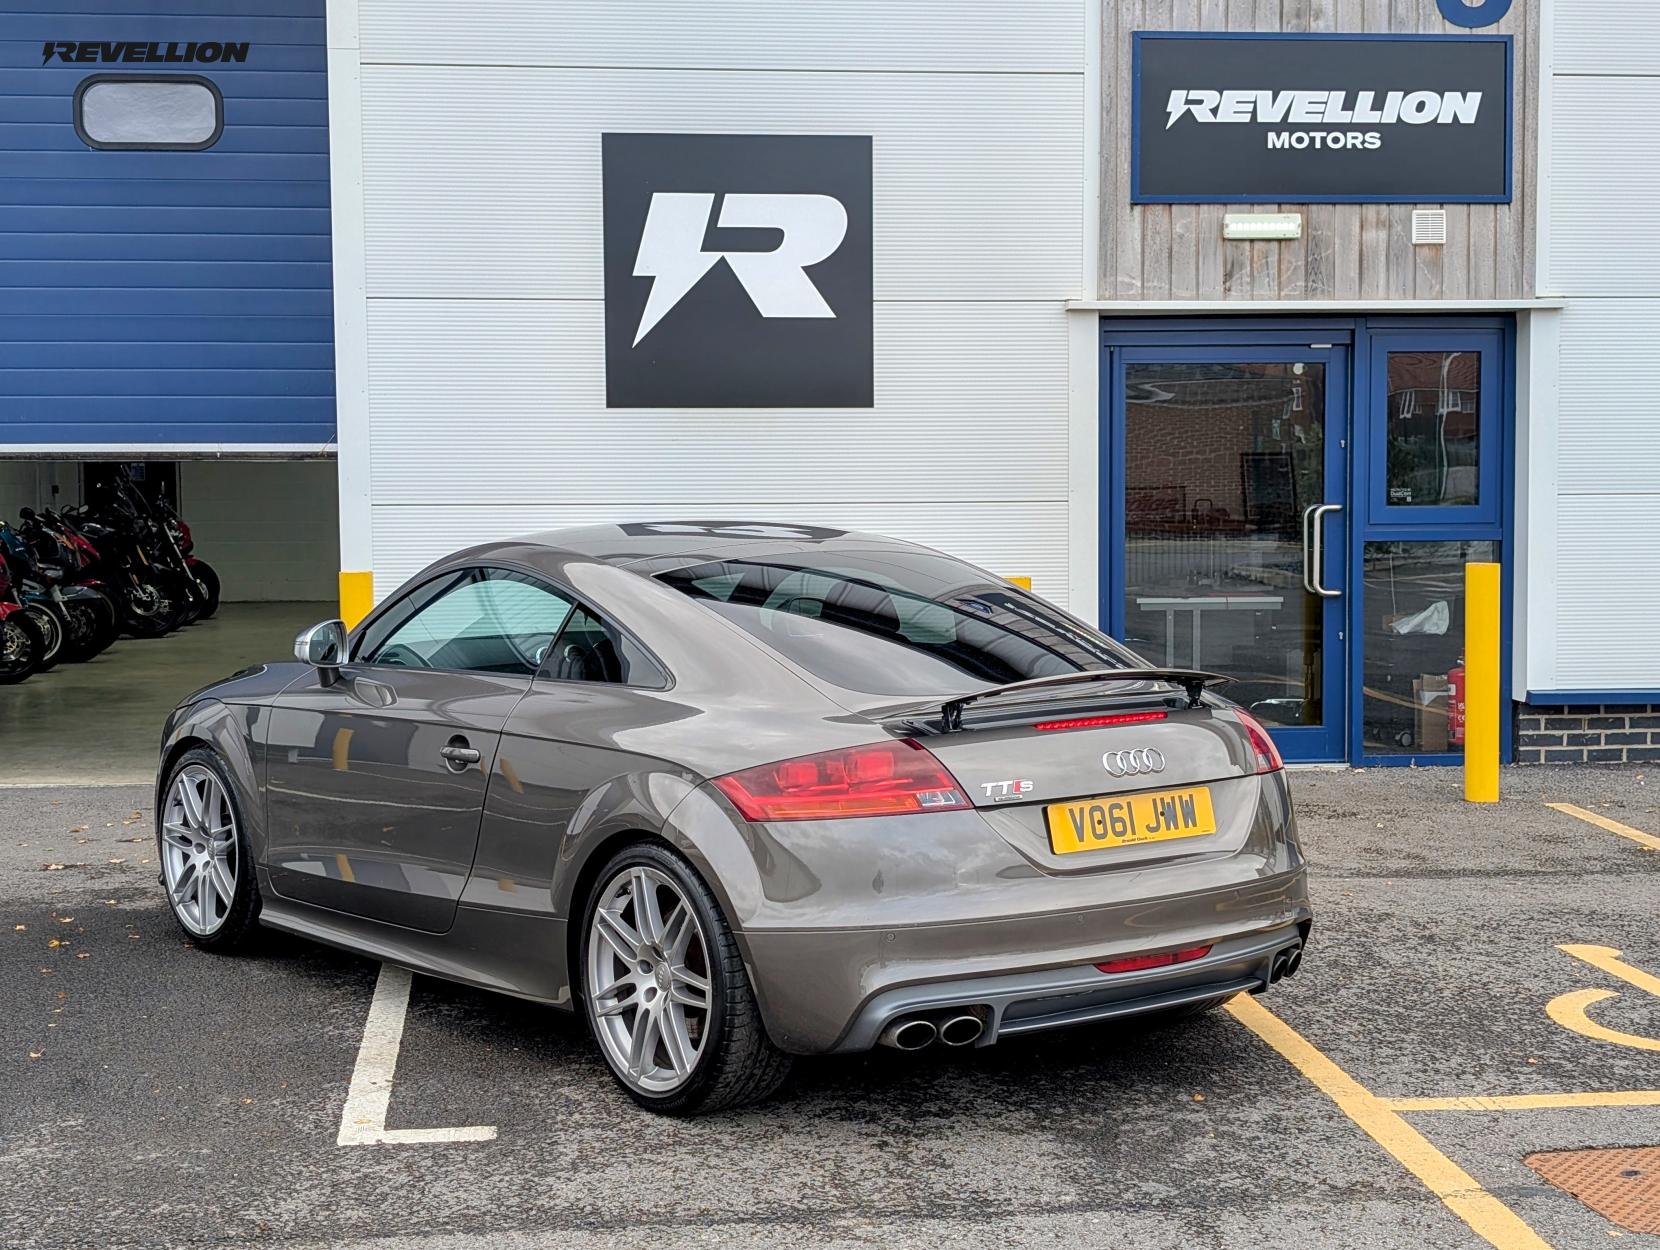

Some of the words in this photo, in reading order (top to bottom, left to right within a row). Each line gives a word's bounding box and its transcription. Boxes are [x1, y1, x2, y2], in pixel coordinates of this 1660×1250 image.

[1165, 90, 1483, 130] REVELLION
[1267, 131, 1382, 149] MOTORS
[980, 779, 1034, 797] TTS
[1145, 794, 1198, 833] JWW
